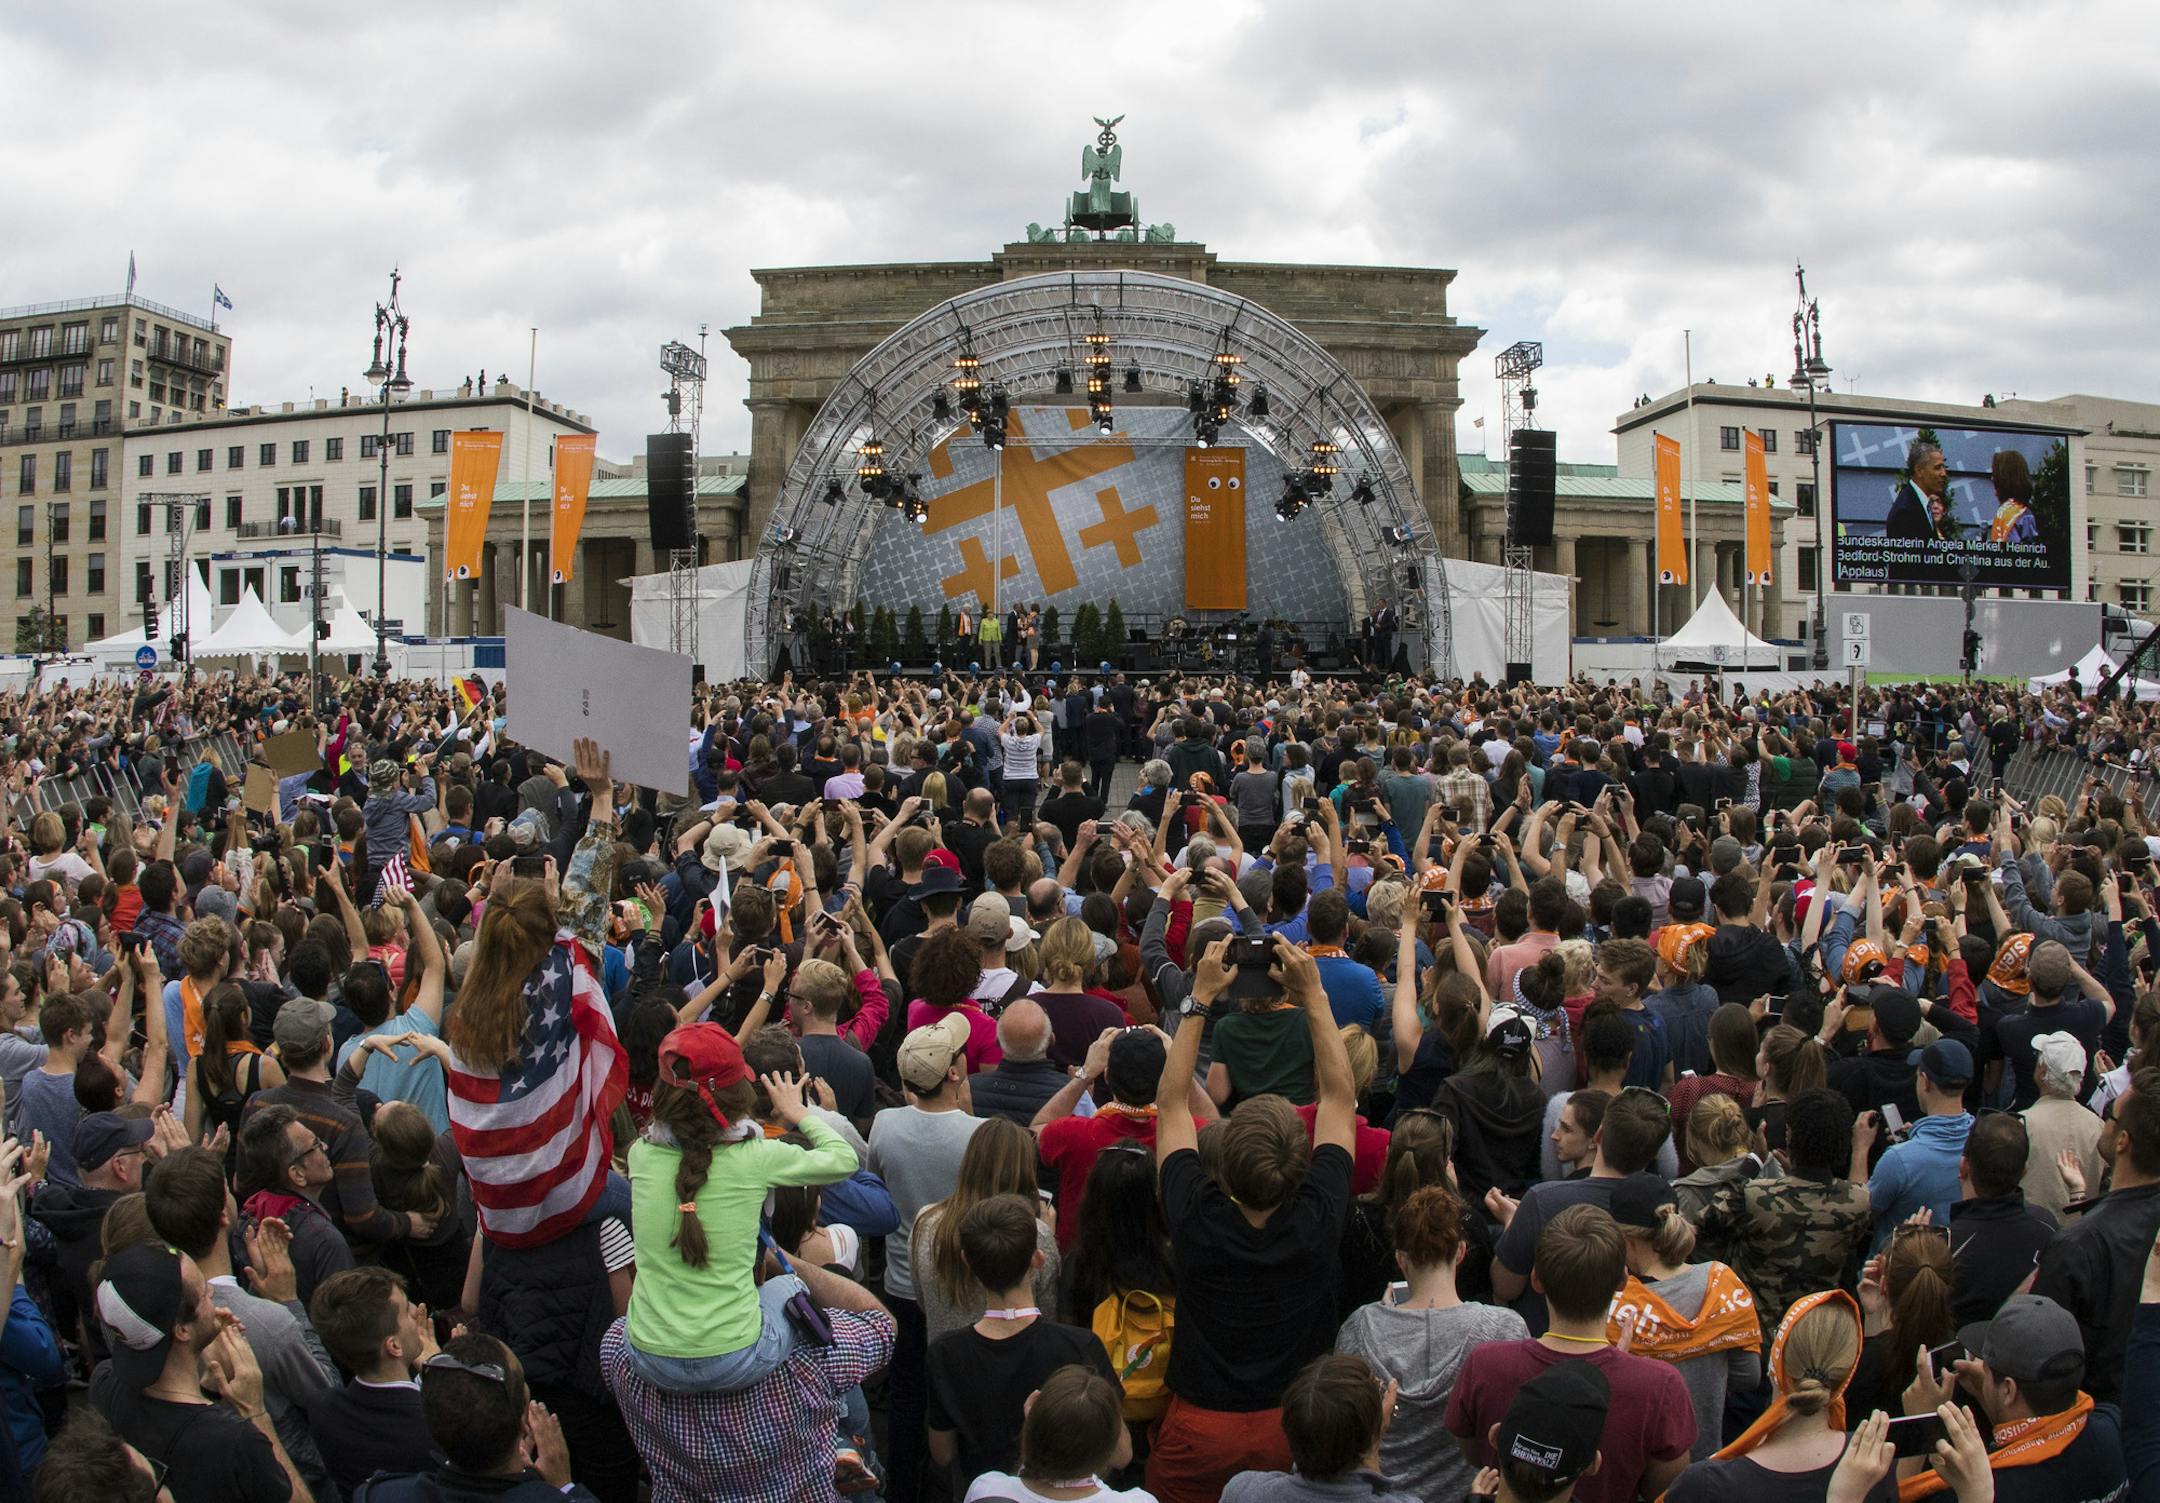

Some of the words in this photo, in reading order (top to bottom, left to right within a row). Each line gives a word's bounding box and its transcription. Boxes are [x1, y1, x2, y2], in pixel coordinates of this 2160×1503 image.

[1190, 504, 1211, 512] siehst
[1838, 536, 1924, 548] Bundeskanzlerin
[1927, 538, 1964, 552] Angela
[1966, 539, 2004, 553] Merkel,
[2006, 541, 2047, 554] Heinrich
[1838, 549, 1921, 563] Bedford-Strohm
[1924, 553, 1944, 564] und
[1946, 553, 1992, 566] Christina
[1994, 558, 2013, 568] aus
[2015, 557, 2032, 568] der
[2033, 557, 2051, 569] Au.
[1838, 563, 1889, 579] Applaus)
